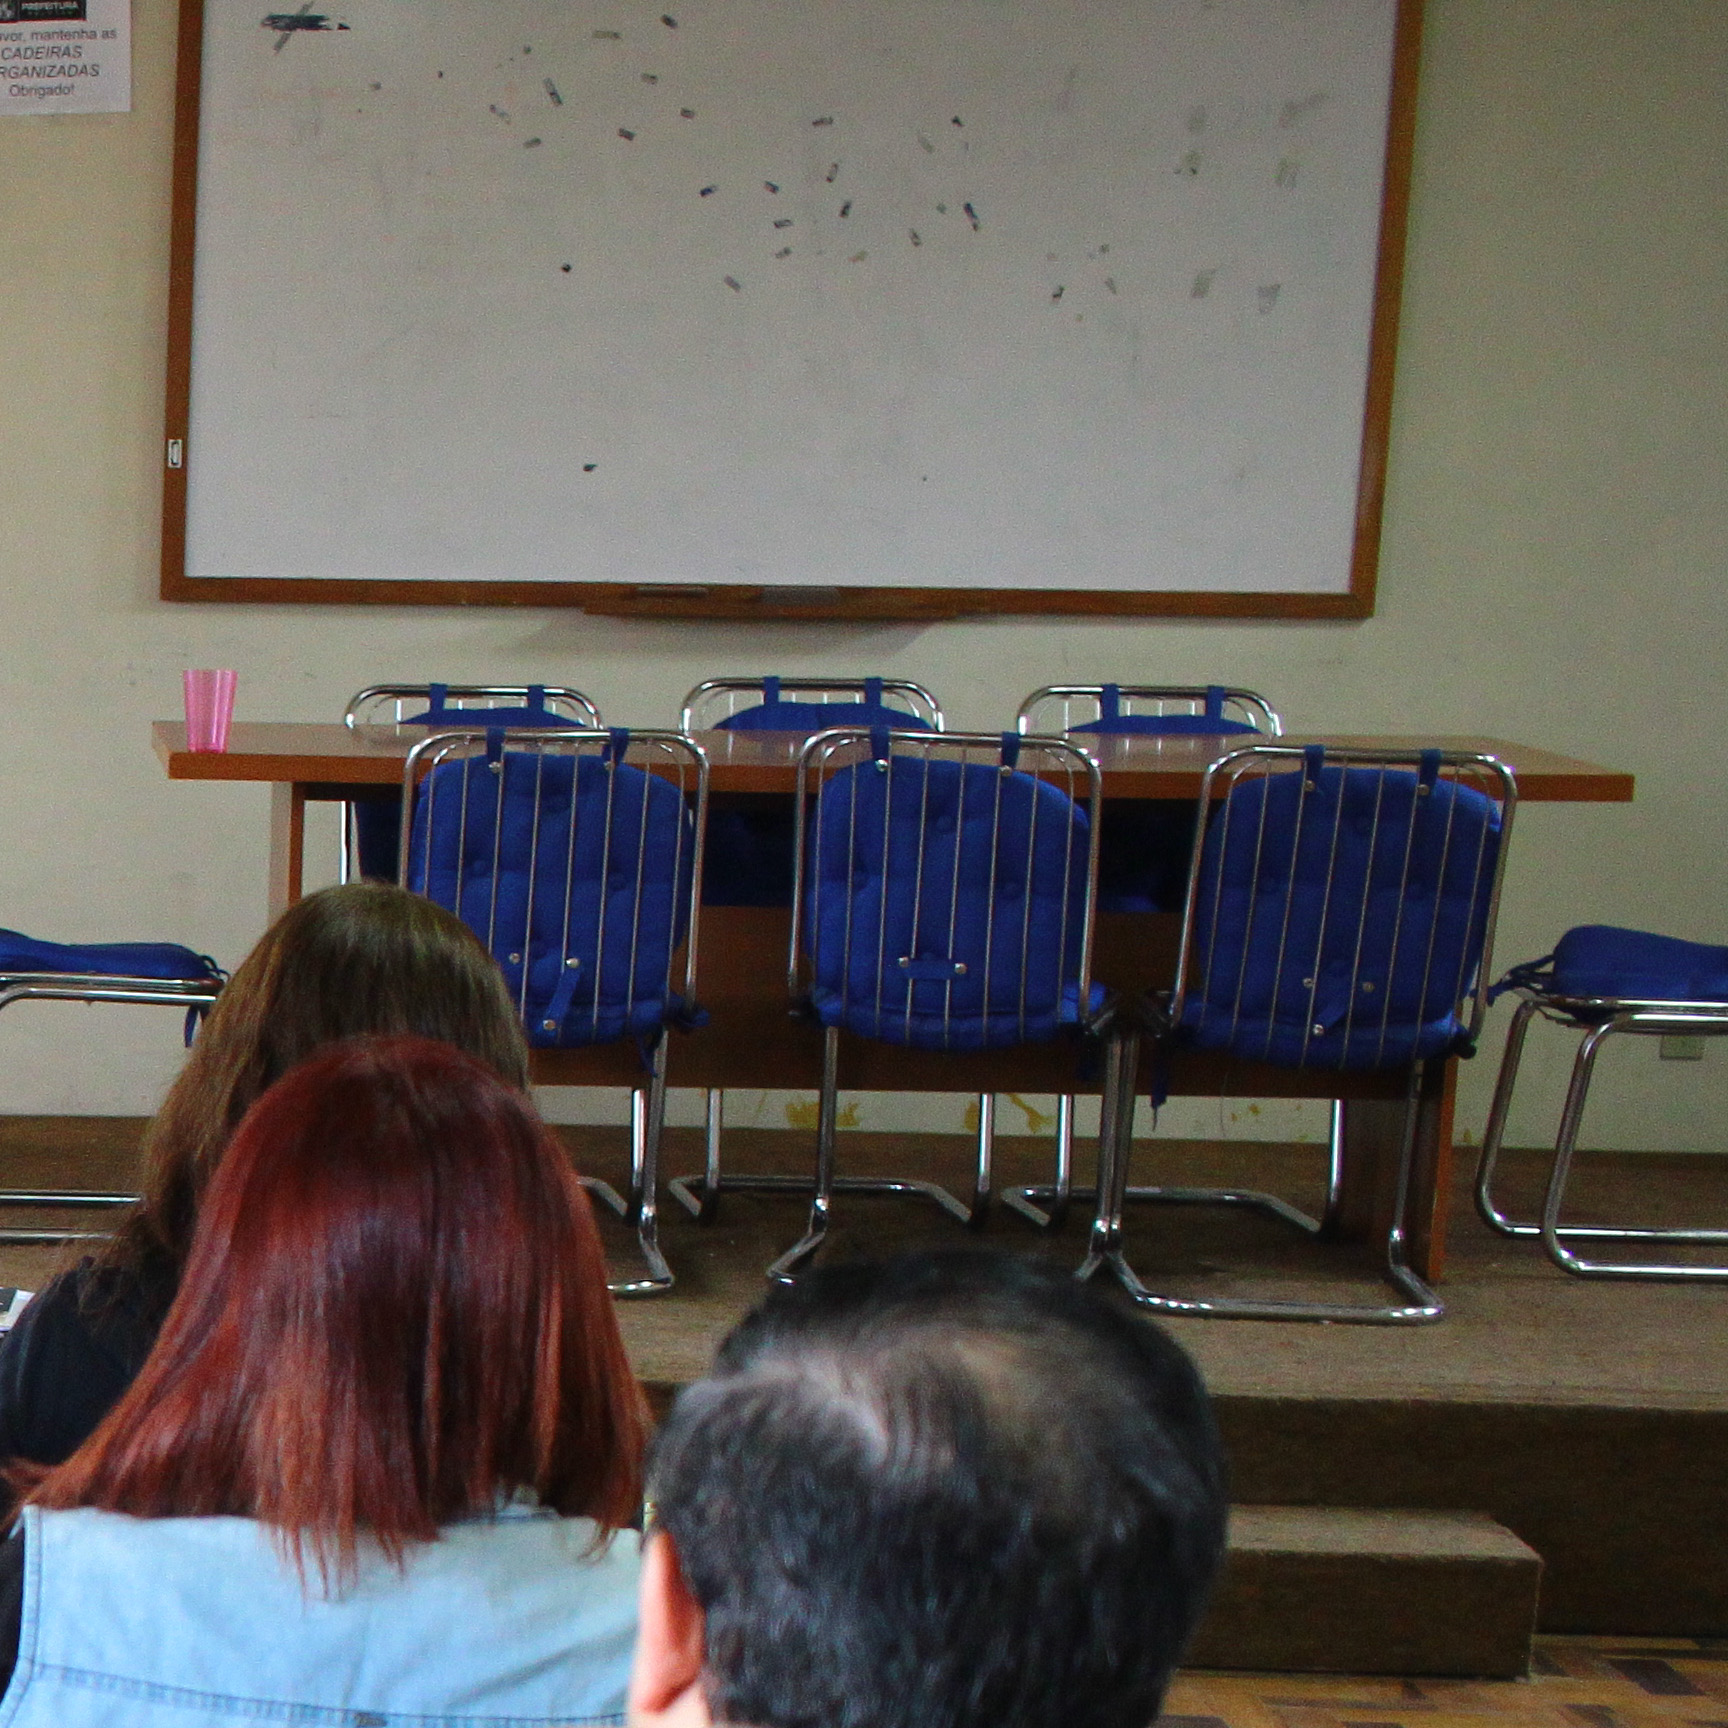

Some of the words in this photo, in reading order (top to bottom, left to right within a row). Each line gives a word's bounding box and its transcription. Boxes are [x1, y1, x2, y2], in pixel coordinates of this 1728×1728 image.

[31, 28, 97, 42] mantenha
[101, 29, 117, 40] as
[0, 45, 83, 60] CADEIRAS
